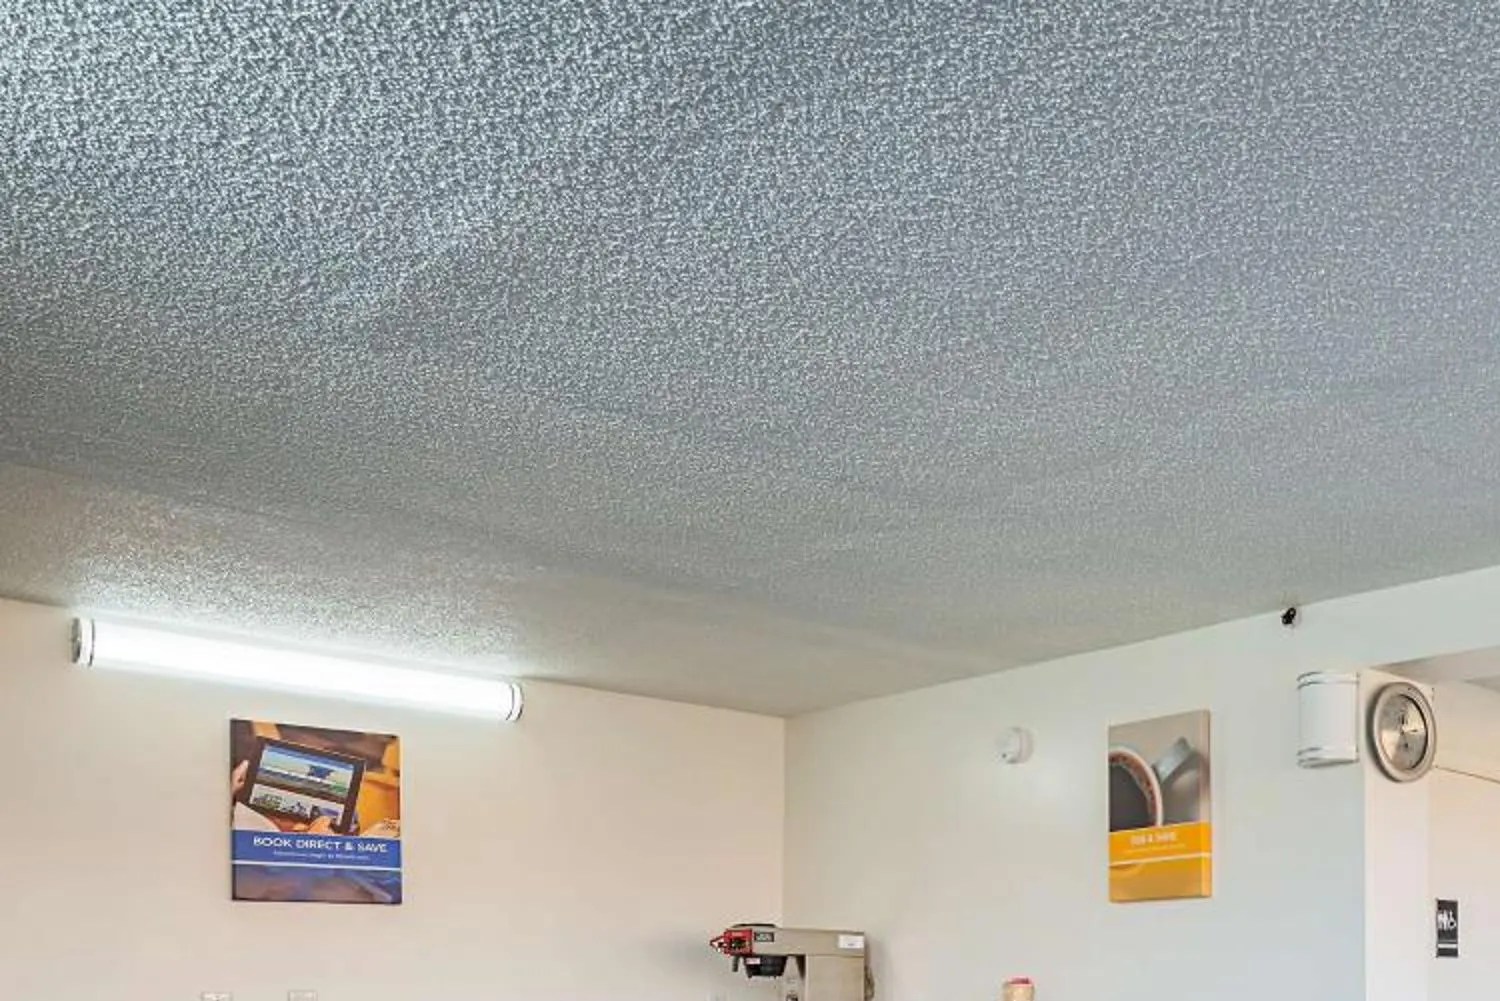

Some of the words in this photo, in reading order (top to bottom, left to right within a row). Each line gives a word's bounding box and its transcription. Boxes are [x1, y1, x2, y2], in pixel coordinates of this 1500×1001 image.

[253, 835, 293, 848] BOOK
[295, 838, 342, 850] DIRECT
[344, 840, 354, 851] &
[357, 841, 389, 853] SAVE
